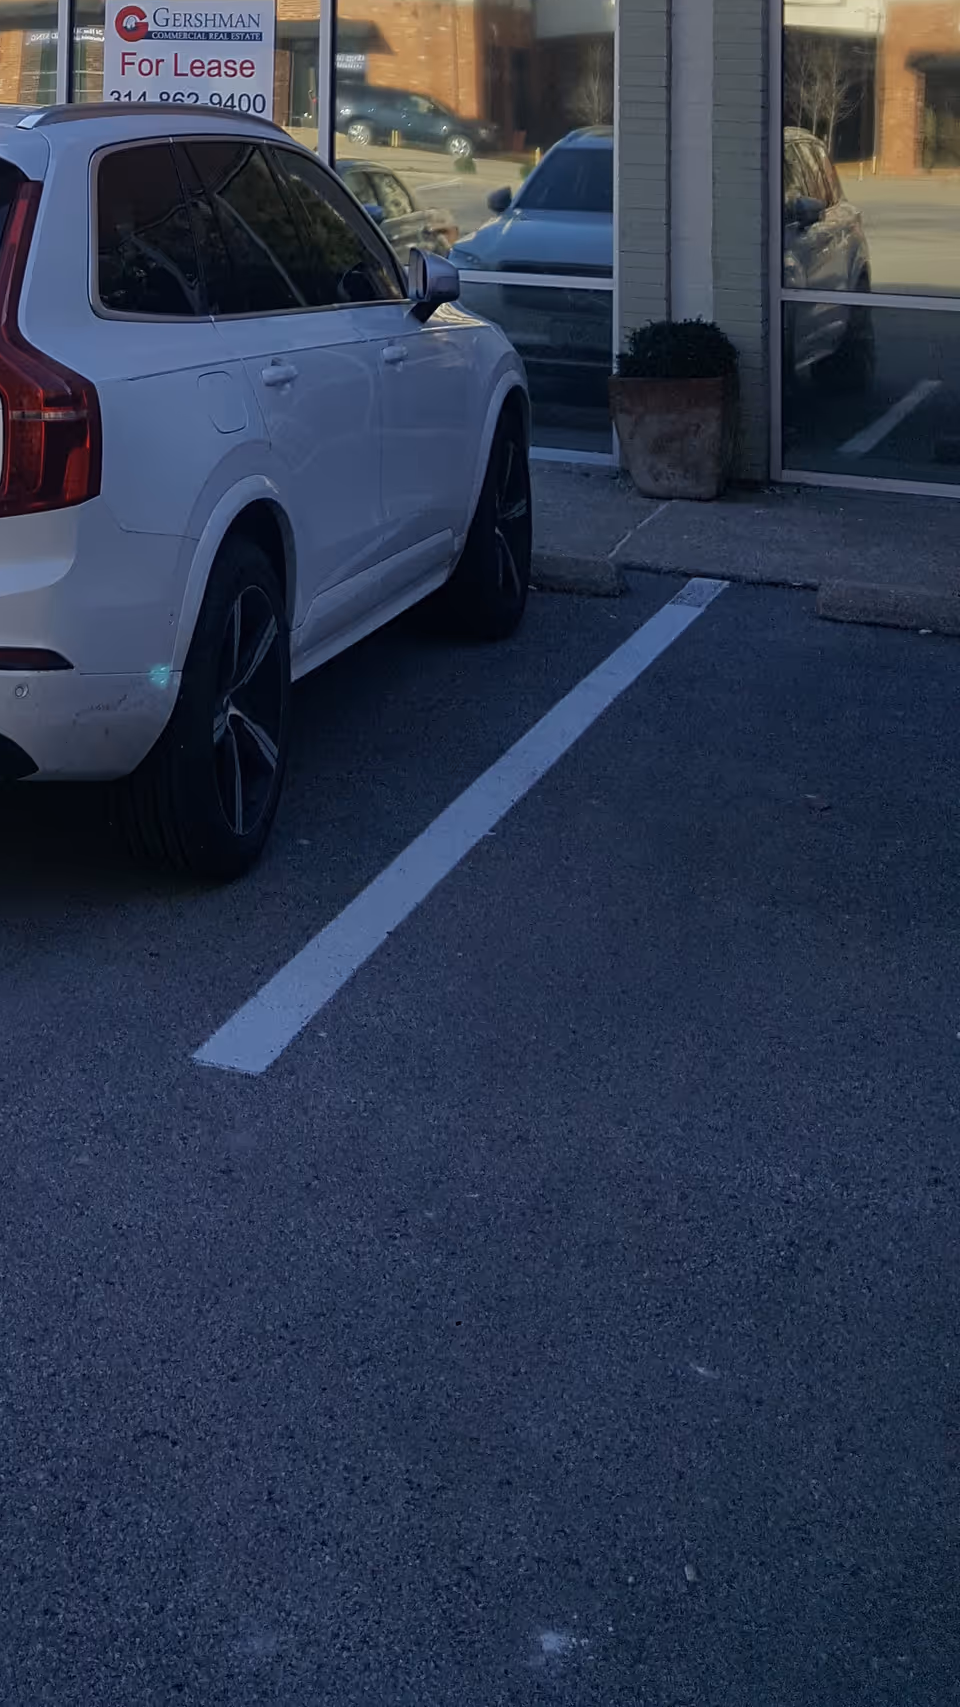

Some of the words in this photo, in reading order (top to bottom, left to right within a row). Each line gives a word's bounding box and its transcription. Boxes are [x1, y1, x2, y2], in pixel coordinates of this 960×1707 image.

[153, 7, 261, 28] GERSHMAN
[151, 31, 206, 40] COMMERCIAL
[208, 32, 230, 40] REAL
[231, 32, 261, 41] ESTATE
[121, 51, 165, 76] For
[173, 52, 256, 78] Lease
[110, 90, 267, 114] 314862-9400
